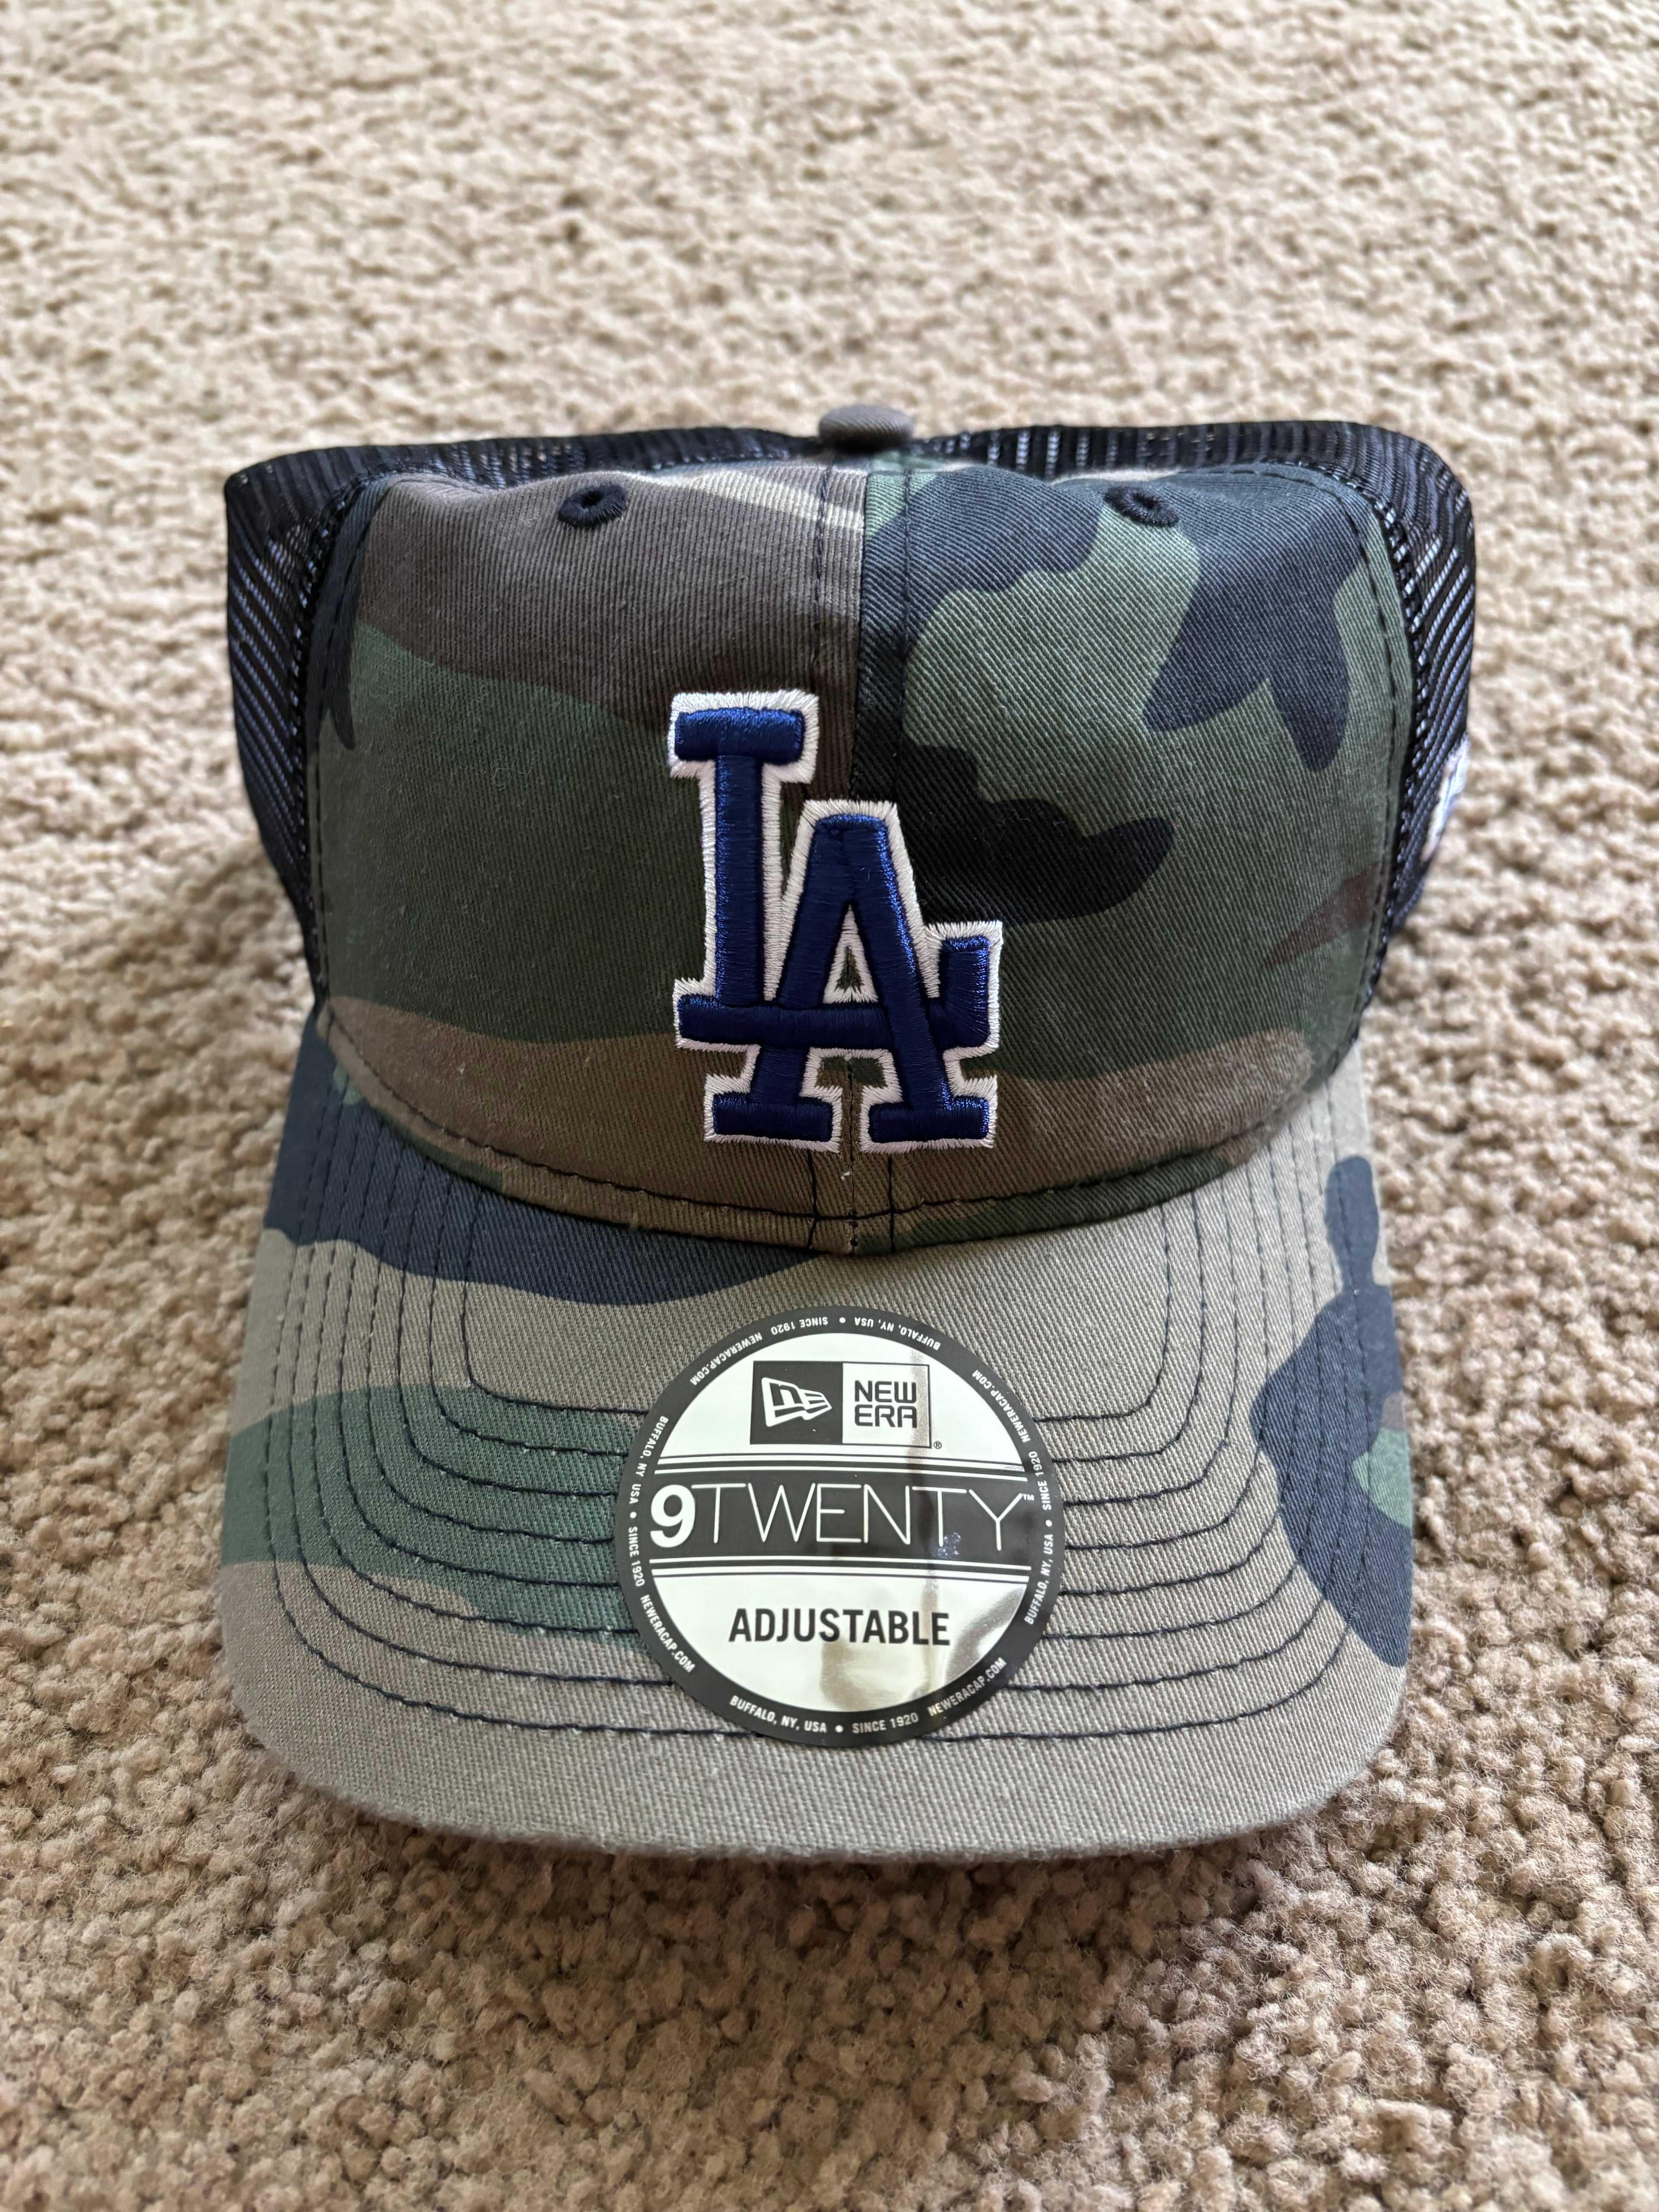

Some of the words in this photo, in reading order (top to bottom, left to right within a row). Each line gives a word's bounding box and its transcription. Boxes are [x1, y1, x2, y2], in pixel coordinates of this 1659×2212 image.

[668, 690, 1003, 1154] LA
[770, 1321, 795, 1335] 1920
[799, 1316, 828, 1328] SINCE
[854, 1317, 874, 1328] USA
[878, 1319, 894, 1332] NY,
[898, 1324, 941, 1350] BUFFALO,
[690, 1332, 763, 1386] NEWERACAP.COM
[855, 1380, 916, 1403] NEW
[855, 1404, 917, 1428] ERA
[972, 1370, 1030, 1443] NEWERACAP.COM
[639, 1415, 669, 1459] BUFFALO,
[1029, 1451, 1044, 1477] 1920
[629, 1484, 642, 1504] USA
[1037, 1480, 1052, 1510] SINCE
[628, 1526, 639, 1557] SINCE
[1043, 1534, 1053, 1554] USA
[631, 1560, 645, 1587] 1920
[1040, 1559, 1053, 1576] NY,
[1024, 1580, 1050, 1624] BUFFALO,
[640, 1594, 696, 1673] NEWERACAP.COM
[728, 1608, 950, 1646] ADJUSTABLE
[730, 1695, 777, 1725] BUFFALO,
[781, 1716, 799, 1731] NY,
[804, 1720, 827, 1733] USA
[852, 1719, 887, 1734] SINCE
[890, 1712, 919, 1729] 1920
[928, 1657, 1007, 1716] NEWERACAP.COM
